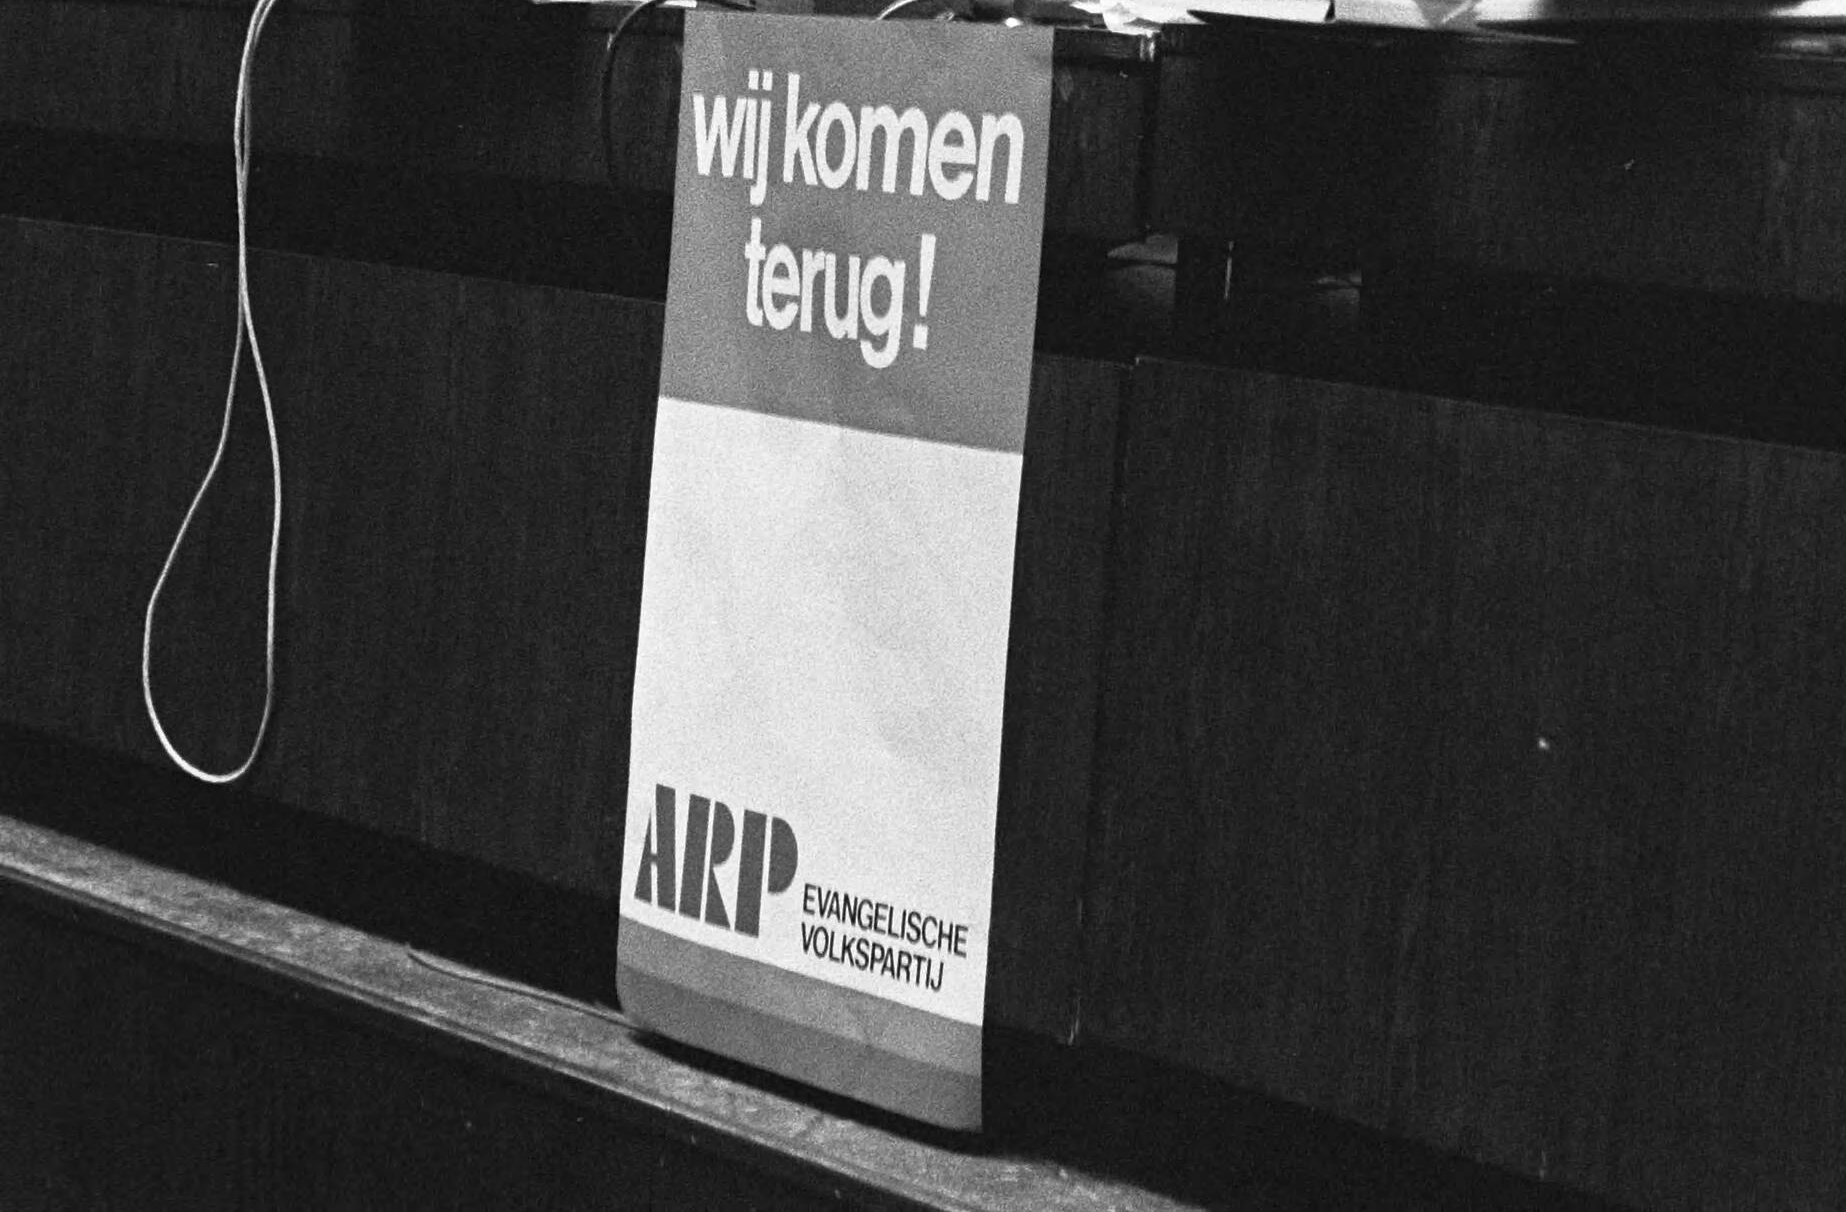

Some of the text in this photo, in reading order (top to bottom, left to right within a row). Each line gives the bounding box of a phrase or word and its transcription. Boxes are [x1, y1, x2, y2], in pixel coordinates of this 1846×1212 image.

[693, 69, 1025, 206] wij komen
[744, 217, 937, 369] terug!
[634, 783, 799, 939] ARP
[802, 883, 969, 958] EVANGELISCHE
[801, 922, 945, 993] VOLKSPARTIJ
